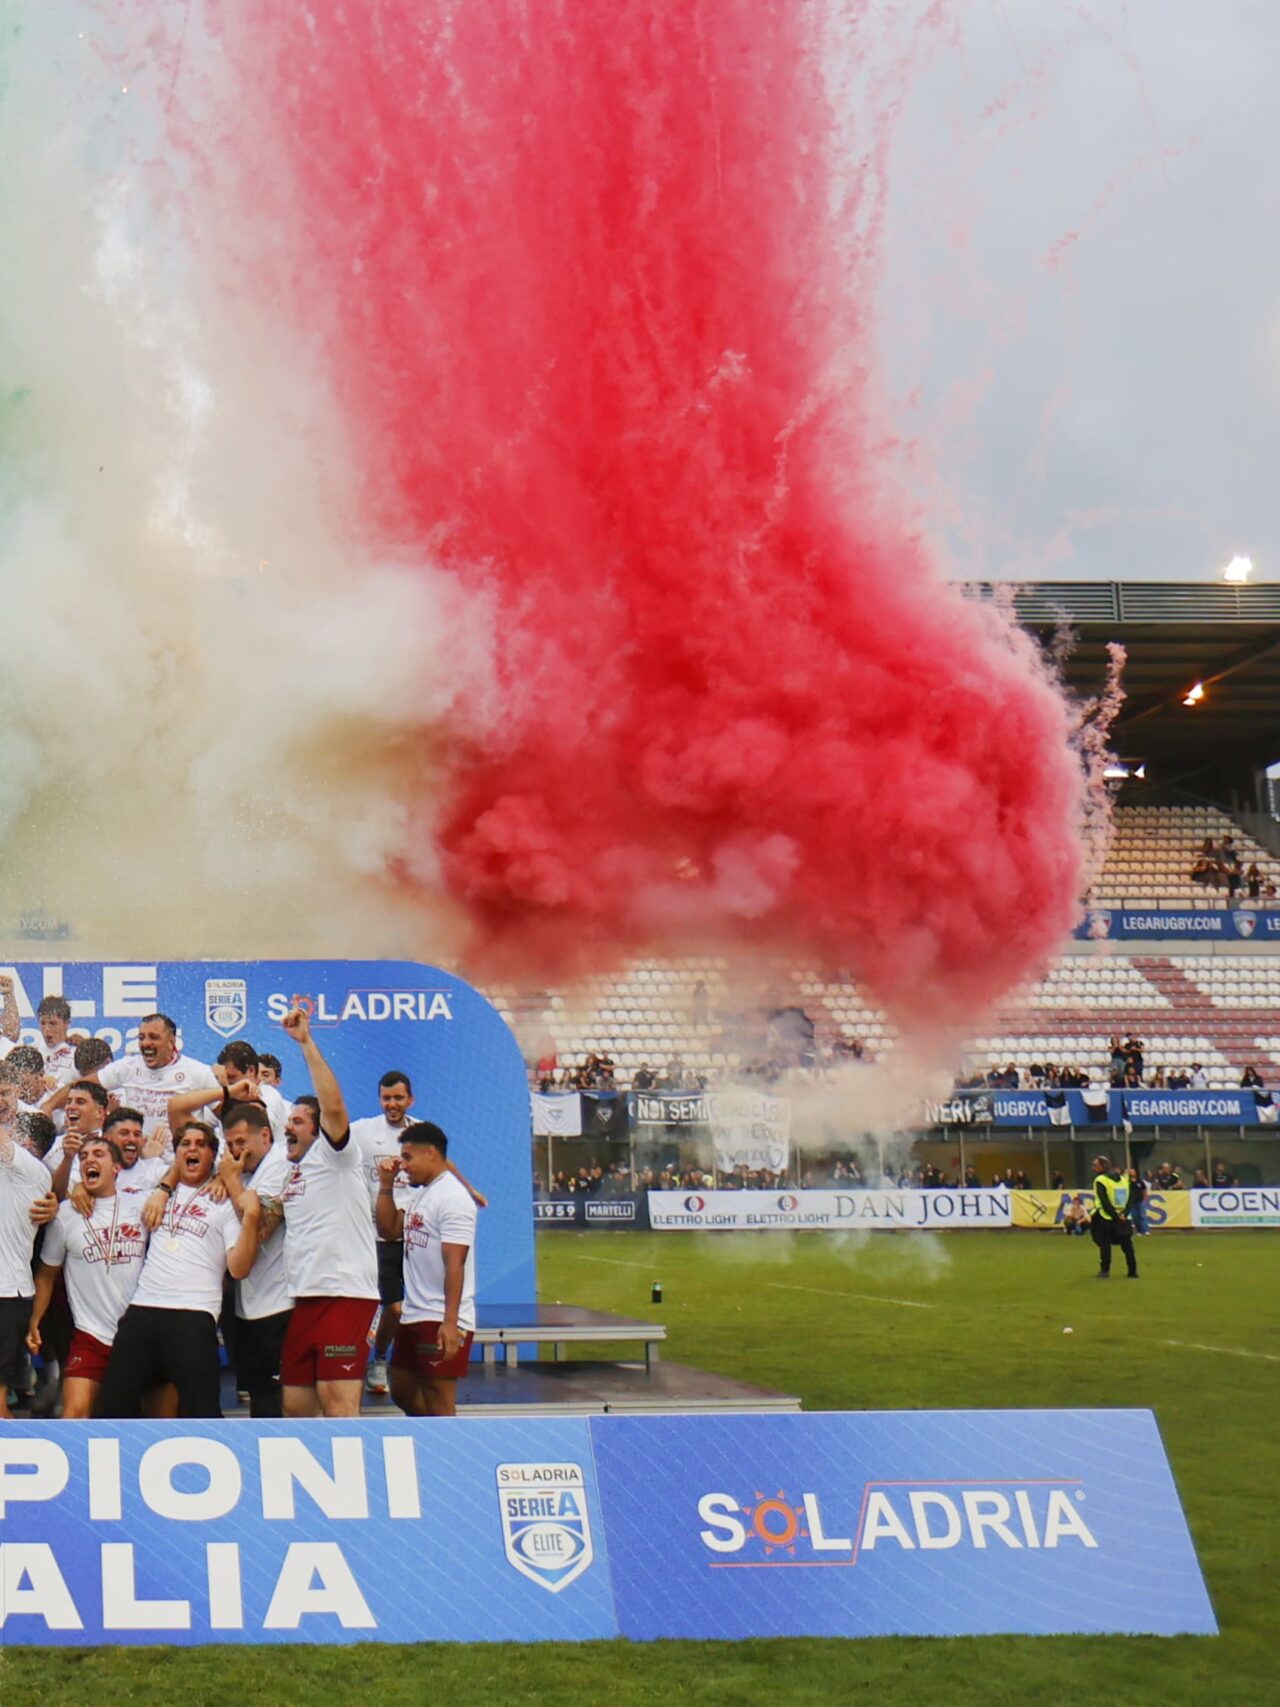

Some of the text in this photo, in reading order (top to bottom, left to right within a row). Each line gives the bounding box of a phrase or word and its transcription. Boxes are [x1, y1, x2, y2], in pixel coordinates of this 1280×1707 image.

[1123, 916, 1221, 931] LEGARUGBY.COM
[537, 1205, 575, 1217] 1959
[589, 1205, 631, 1217] MARTELLI
[834, 1193, 1010, 1225] DAN JOHN
[653, 1214, 737, 1225] ELETTRO LIGHT
[746, 1213, 831, 1224] ELETTRO LIGHT
[507, 1491, 581, 1518] SERIE A
[533, 1533, 565, 1552] ELITE
